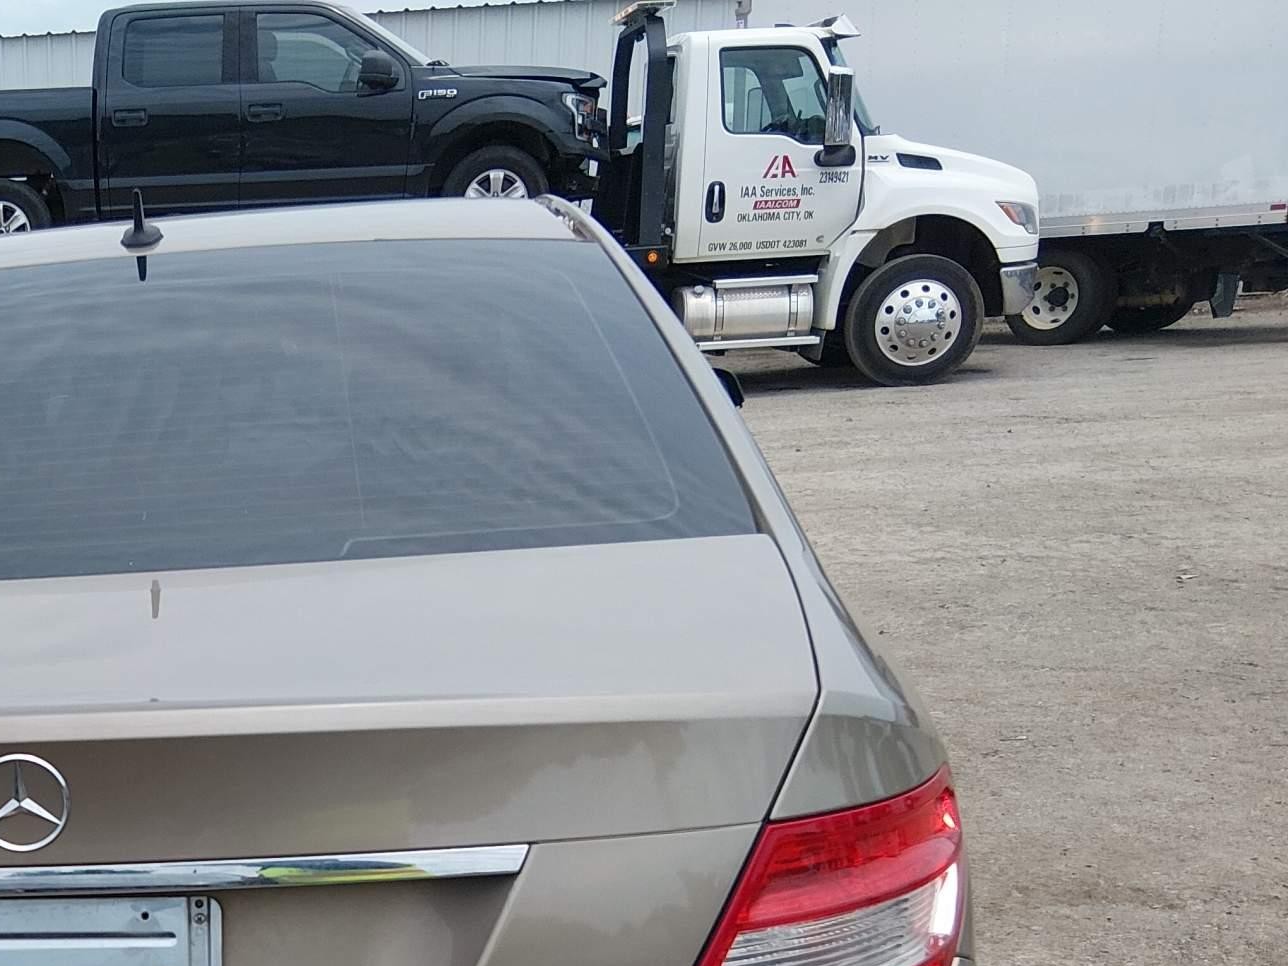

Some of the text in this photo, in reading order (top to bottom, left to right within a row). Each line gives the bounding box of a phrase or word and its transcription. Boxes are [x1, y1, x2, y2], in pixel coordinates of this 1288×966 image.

[819, 171, 849, 183] 23149421
[740, 184, 815, 198] IAA Services, Inc.
[756, 200, 798, 209] IAAI.COM
[737, 210, 814, 223] OKLAHOMA CITY, OK
[708, 239, 807, 252] GVW 26,000 USDOT 423081
